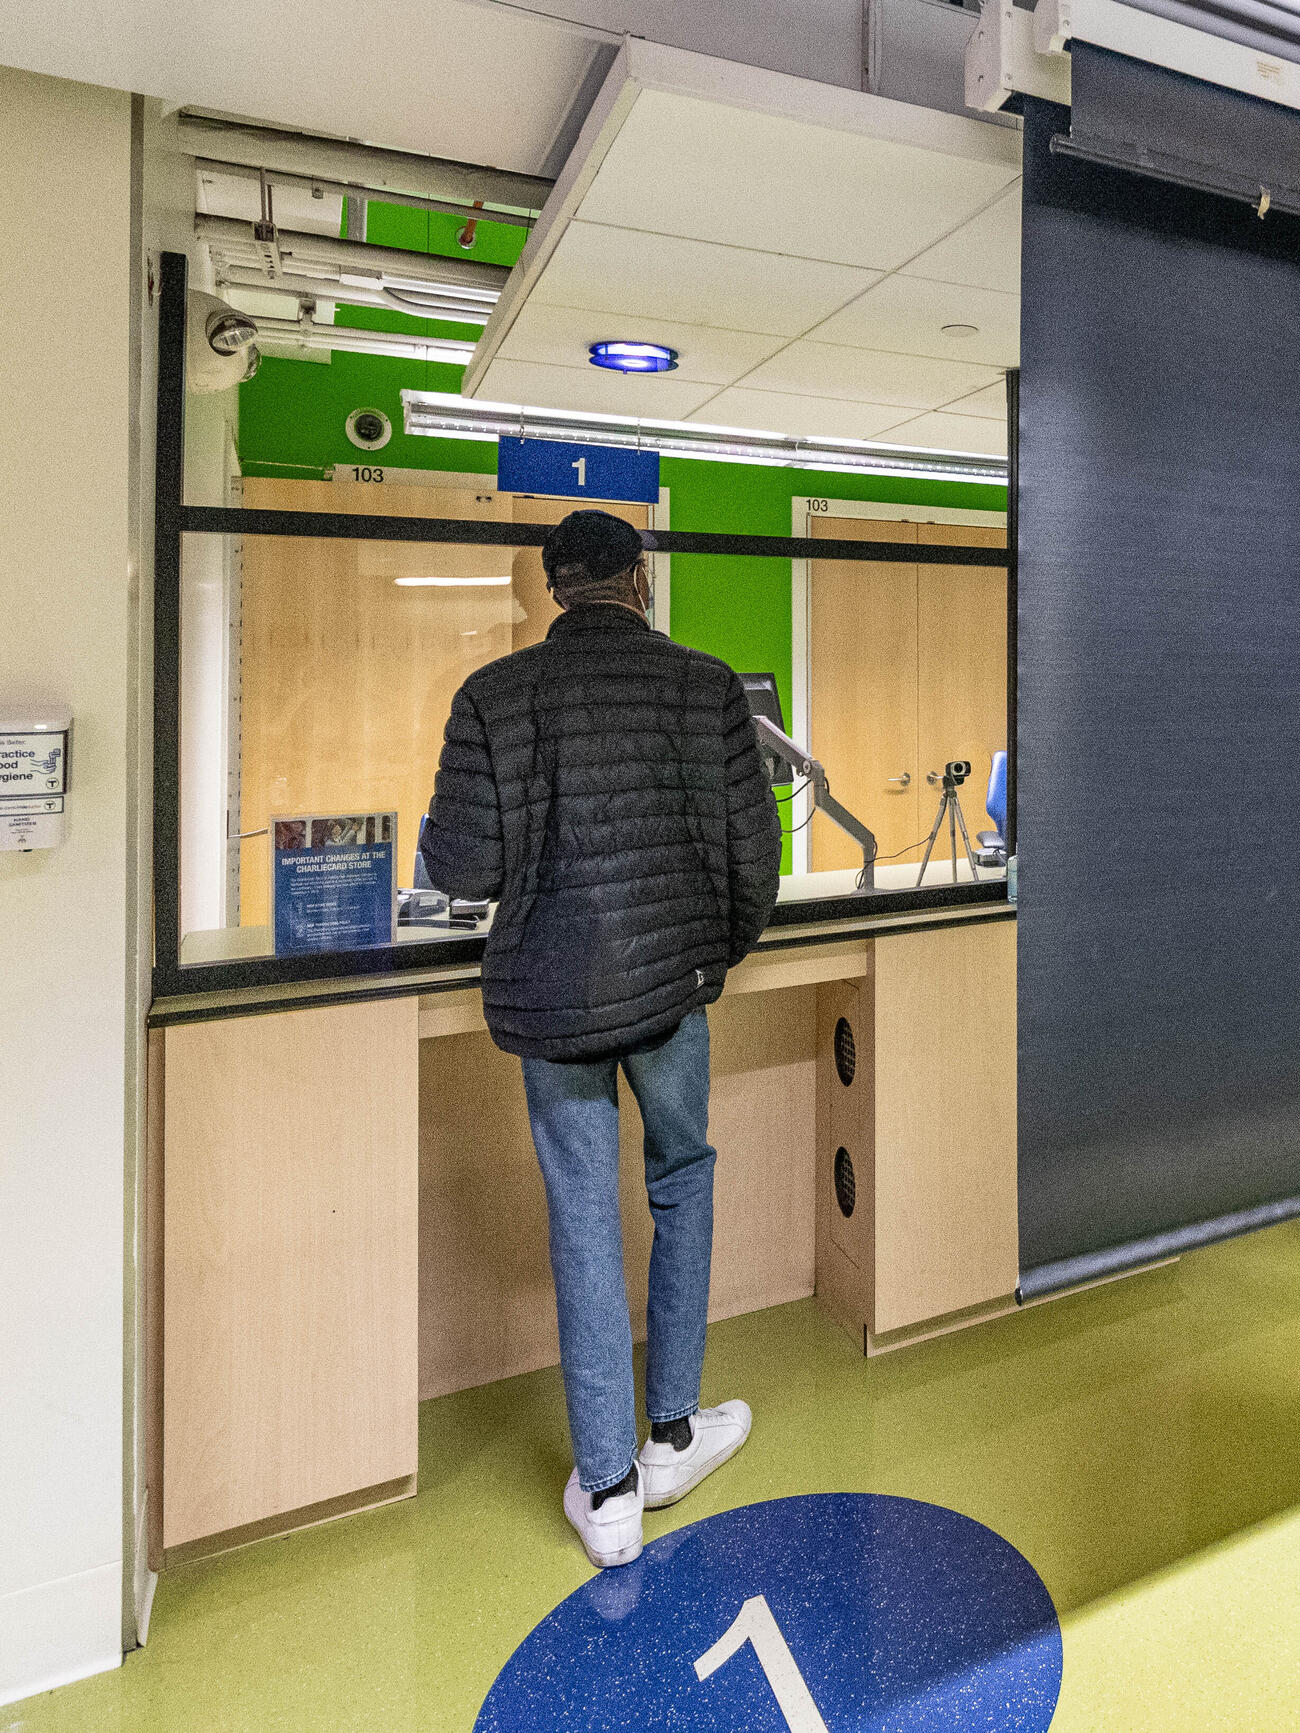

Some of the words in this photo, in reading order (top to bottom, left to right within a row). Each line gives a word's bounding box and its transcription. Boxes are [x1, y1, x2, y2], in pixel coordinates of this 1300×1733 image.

[352, 467, 384, 483] 103
[571, 457, 586, 486] 1
[806, 499, 828, 512] 103
[282, 855, 324, 865] IMPORTANT
[326, 853, 360, 862] CHANGES
[373, 851, 386, 859] THE
[296, 862, 347, 873] CHARLIECARD
[349, 861, 372, 869] STORE
[693, 1594, 830, 1733] 1
